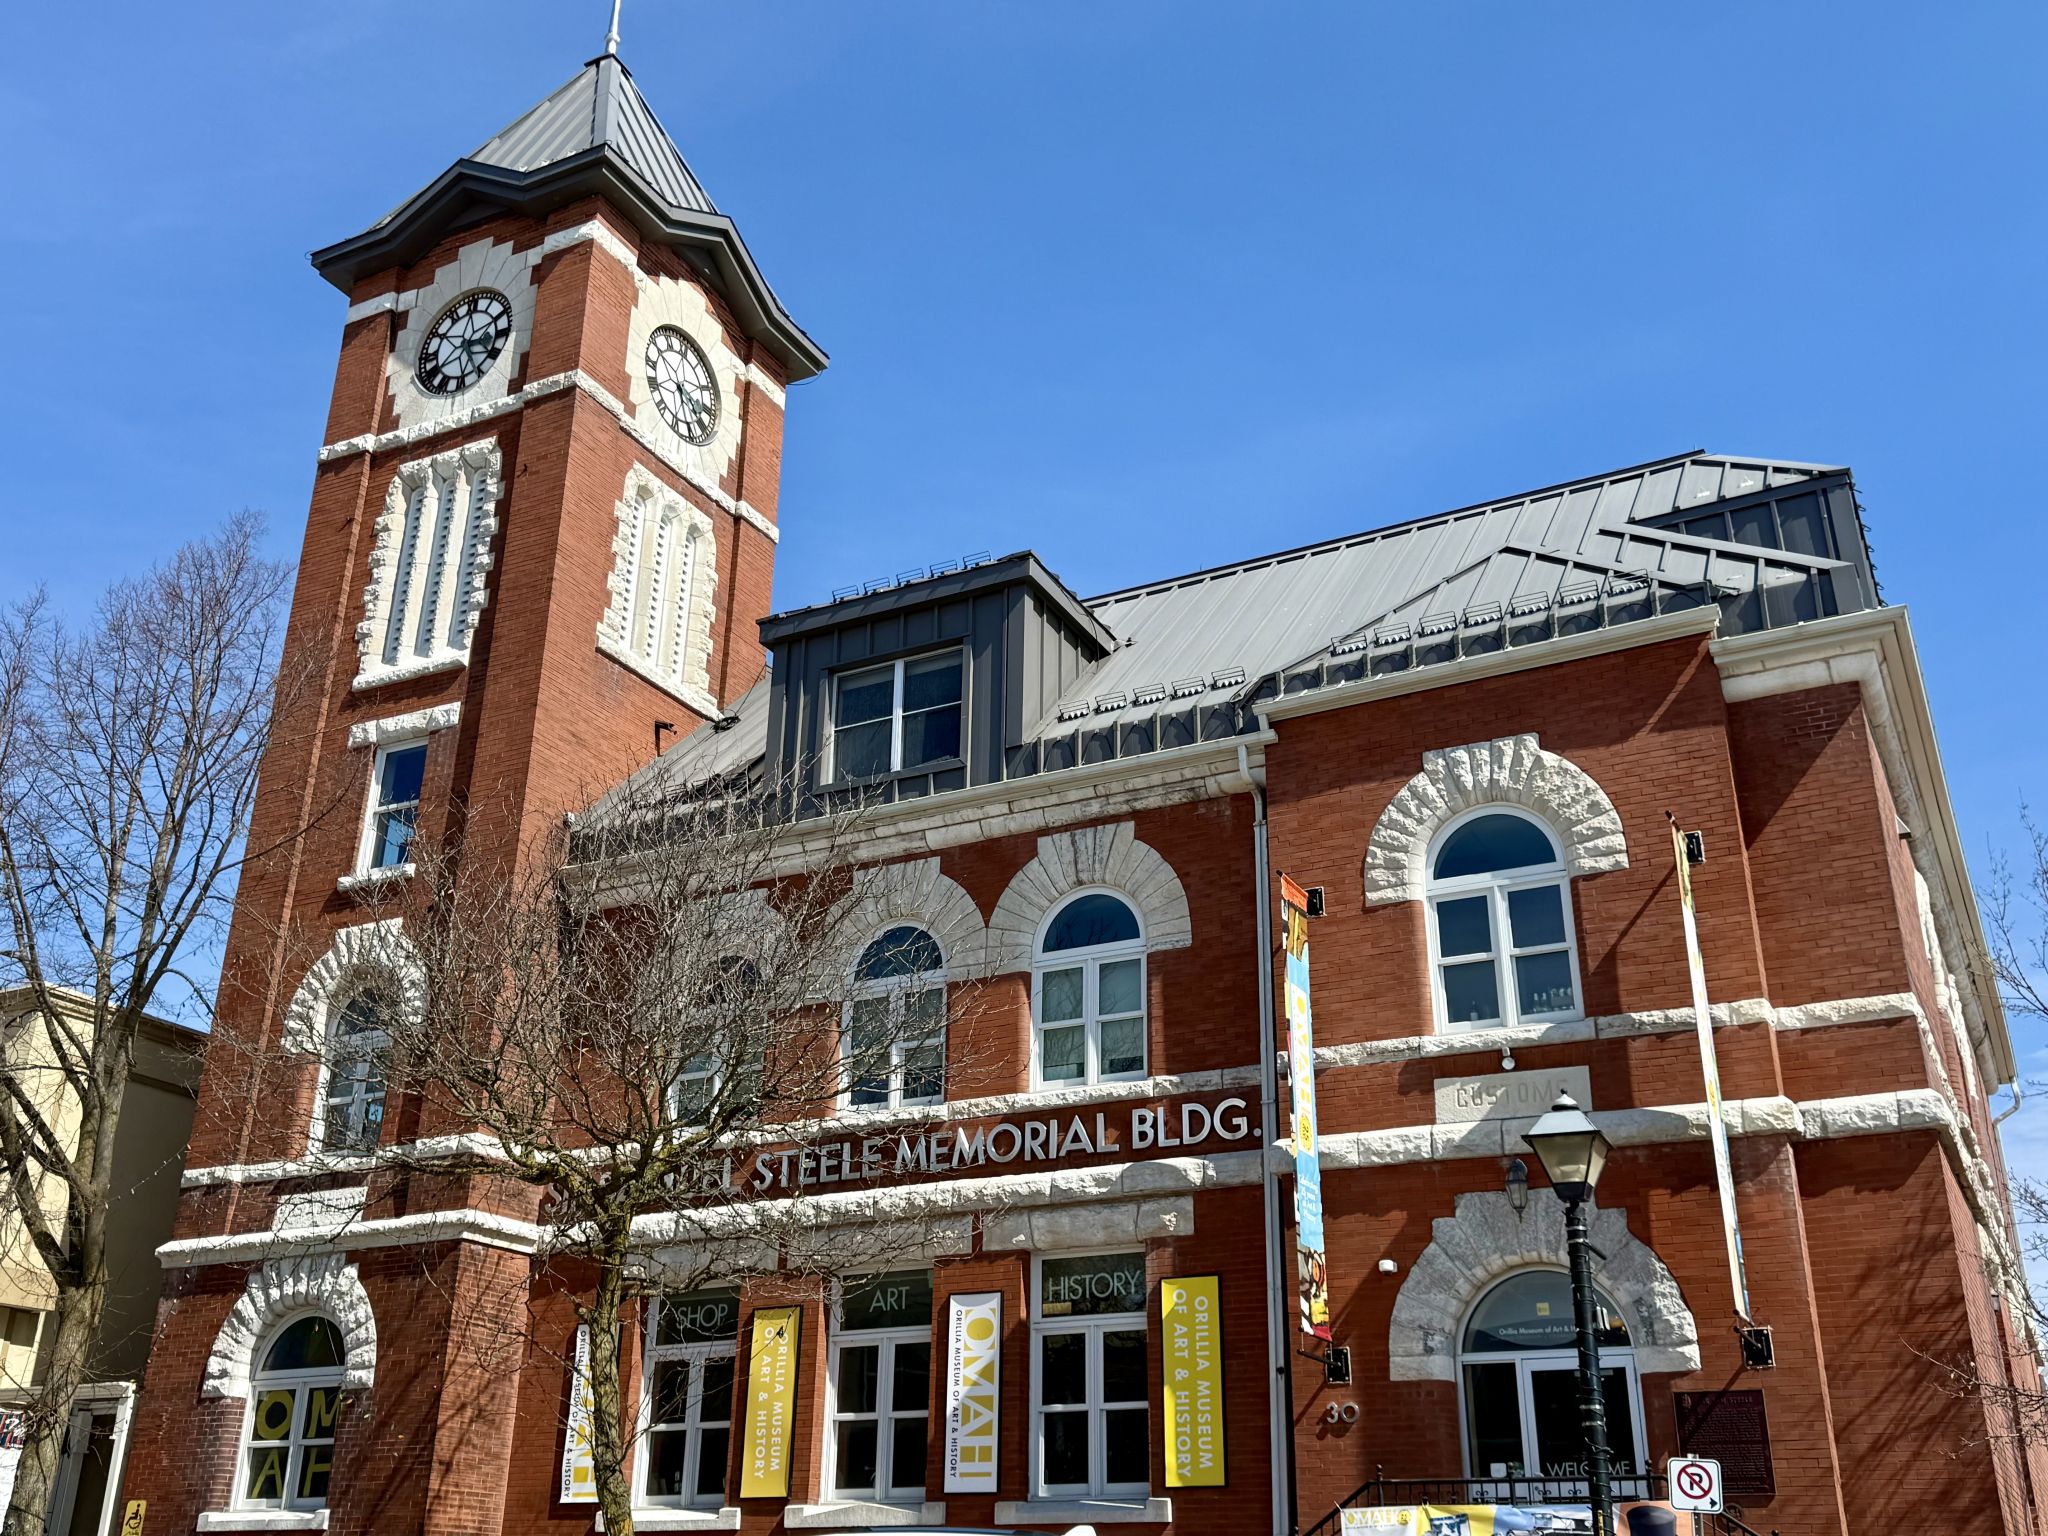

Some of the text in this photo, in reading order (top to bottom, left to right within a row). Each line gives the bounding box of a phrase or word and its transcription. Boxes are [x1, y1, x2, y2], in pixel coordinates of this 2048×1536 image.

[752, 1137, 882, 1191] STEELE
[895, 1113, 1119, 1171] MEMORIAL
[1132, 1098, 1262, 1150] BLDG.
[869, 1286, 910, 1312] ART
[1048, 1270, 1141, 1301] HISTORY
[676, 1304, 728, 1329] SHOP
[955, 1309, 963, 1344] ORILLIA
[1553, 1325, 1562, 1333] Art
[953, 1348, 961, 1387] MUSEUM
[1172, 1288, 1192, 1477] OF ART & HISTORY
[1194, 1295, 1213, 1469] ORILLIA MUSEUM
[754, 1327, 775, 1479] OF ART & HISTORY
[770, 1332, 789, 1471] ORILLIA MUSEUM
[952, 1390, 959, 1402] OF
[959, 1307, 998, 1478] OMAH
[571, 1411, 578, 1423] OF
[1326, 1401, 1360, 1424] 30
[950, 1437, 958, 1478] HISTORY
[1547, 1460, 1630, 1477] WELCME
[563, 1458, 572, 1498] HISTORY
